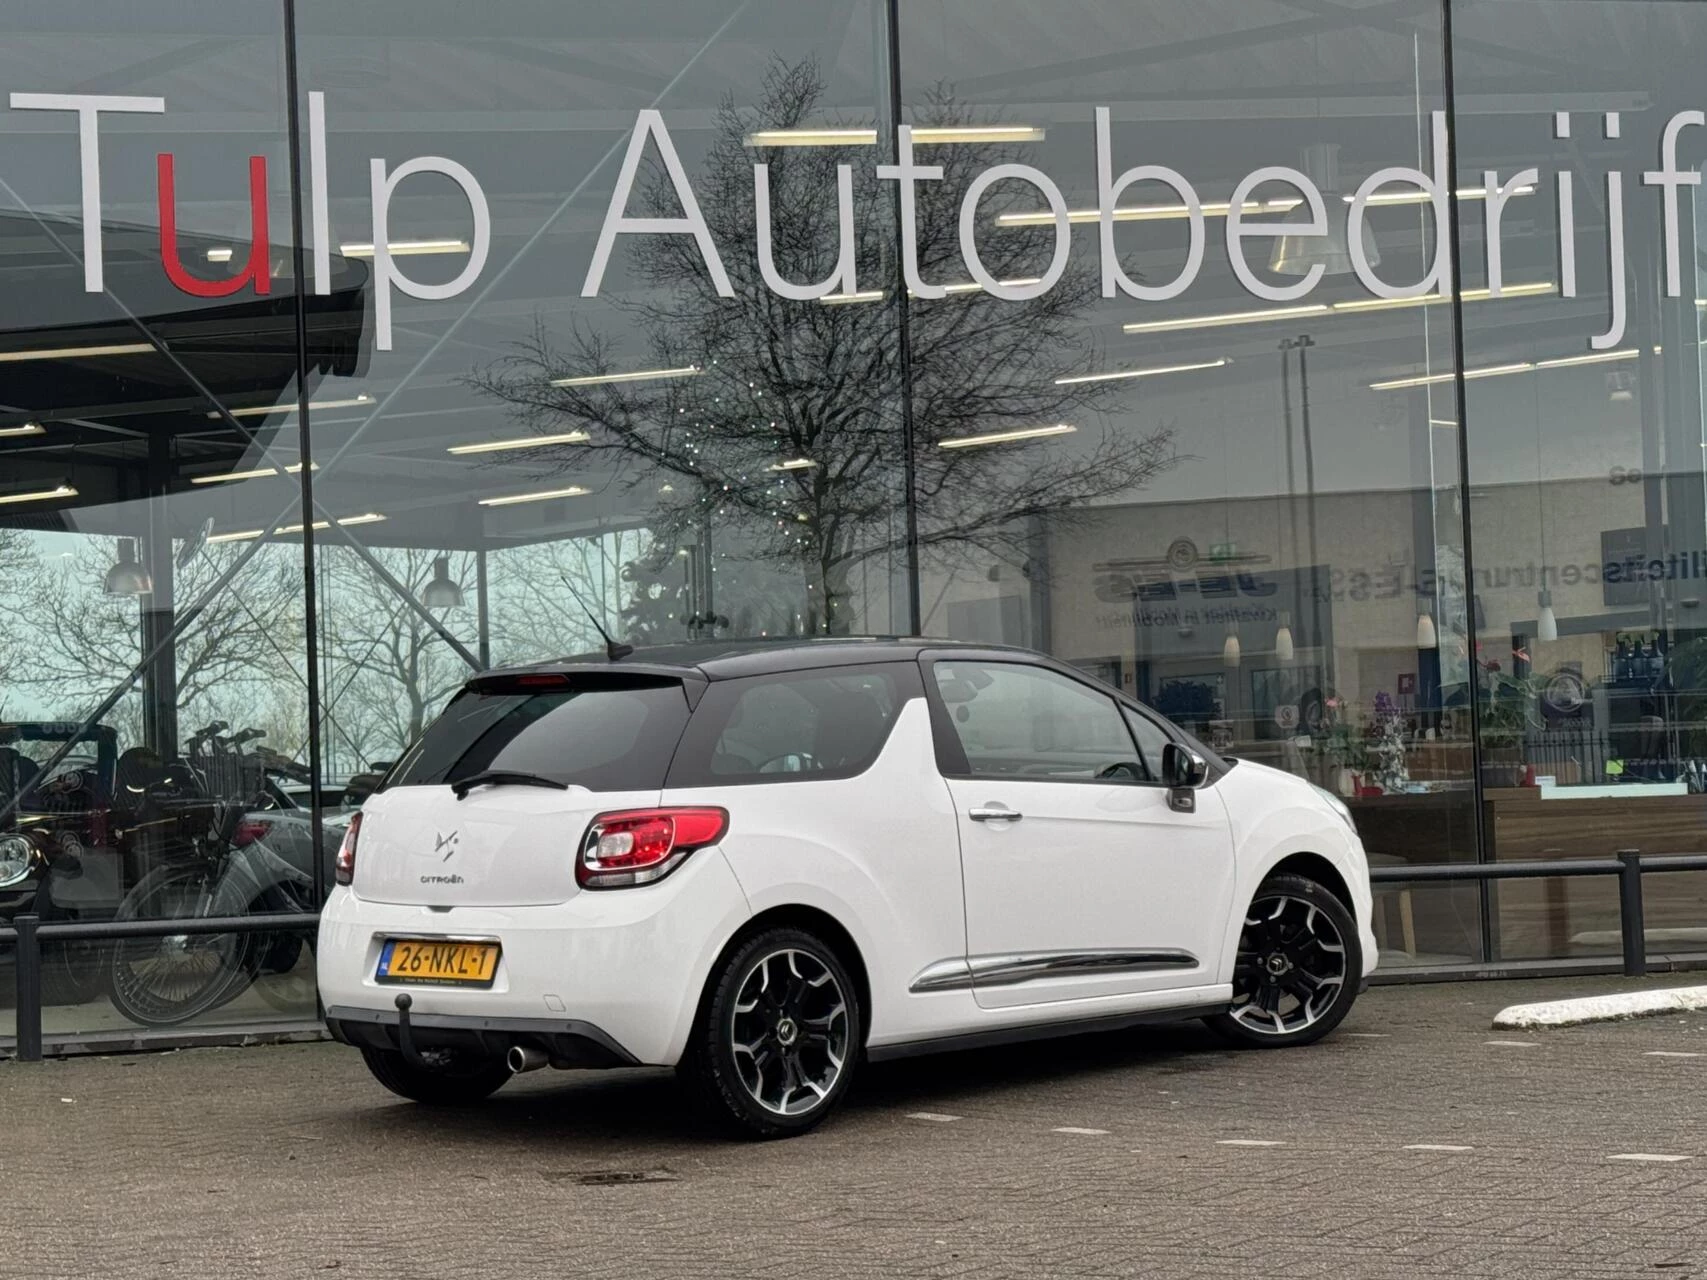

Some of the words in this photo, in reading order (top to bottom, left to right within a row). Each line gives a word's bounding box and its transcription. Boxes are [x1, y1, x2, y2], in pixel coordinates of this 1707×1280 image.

[10, 91, 491, 351] Tulp
[581, 106, 1705, 350] Autobedrijf
[397, 945, 487, 975] 26-NKL-1
